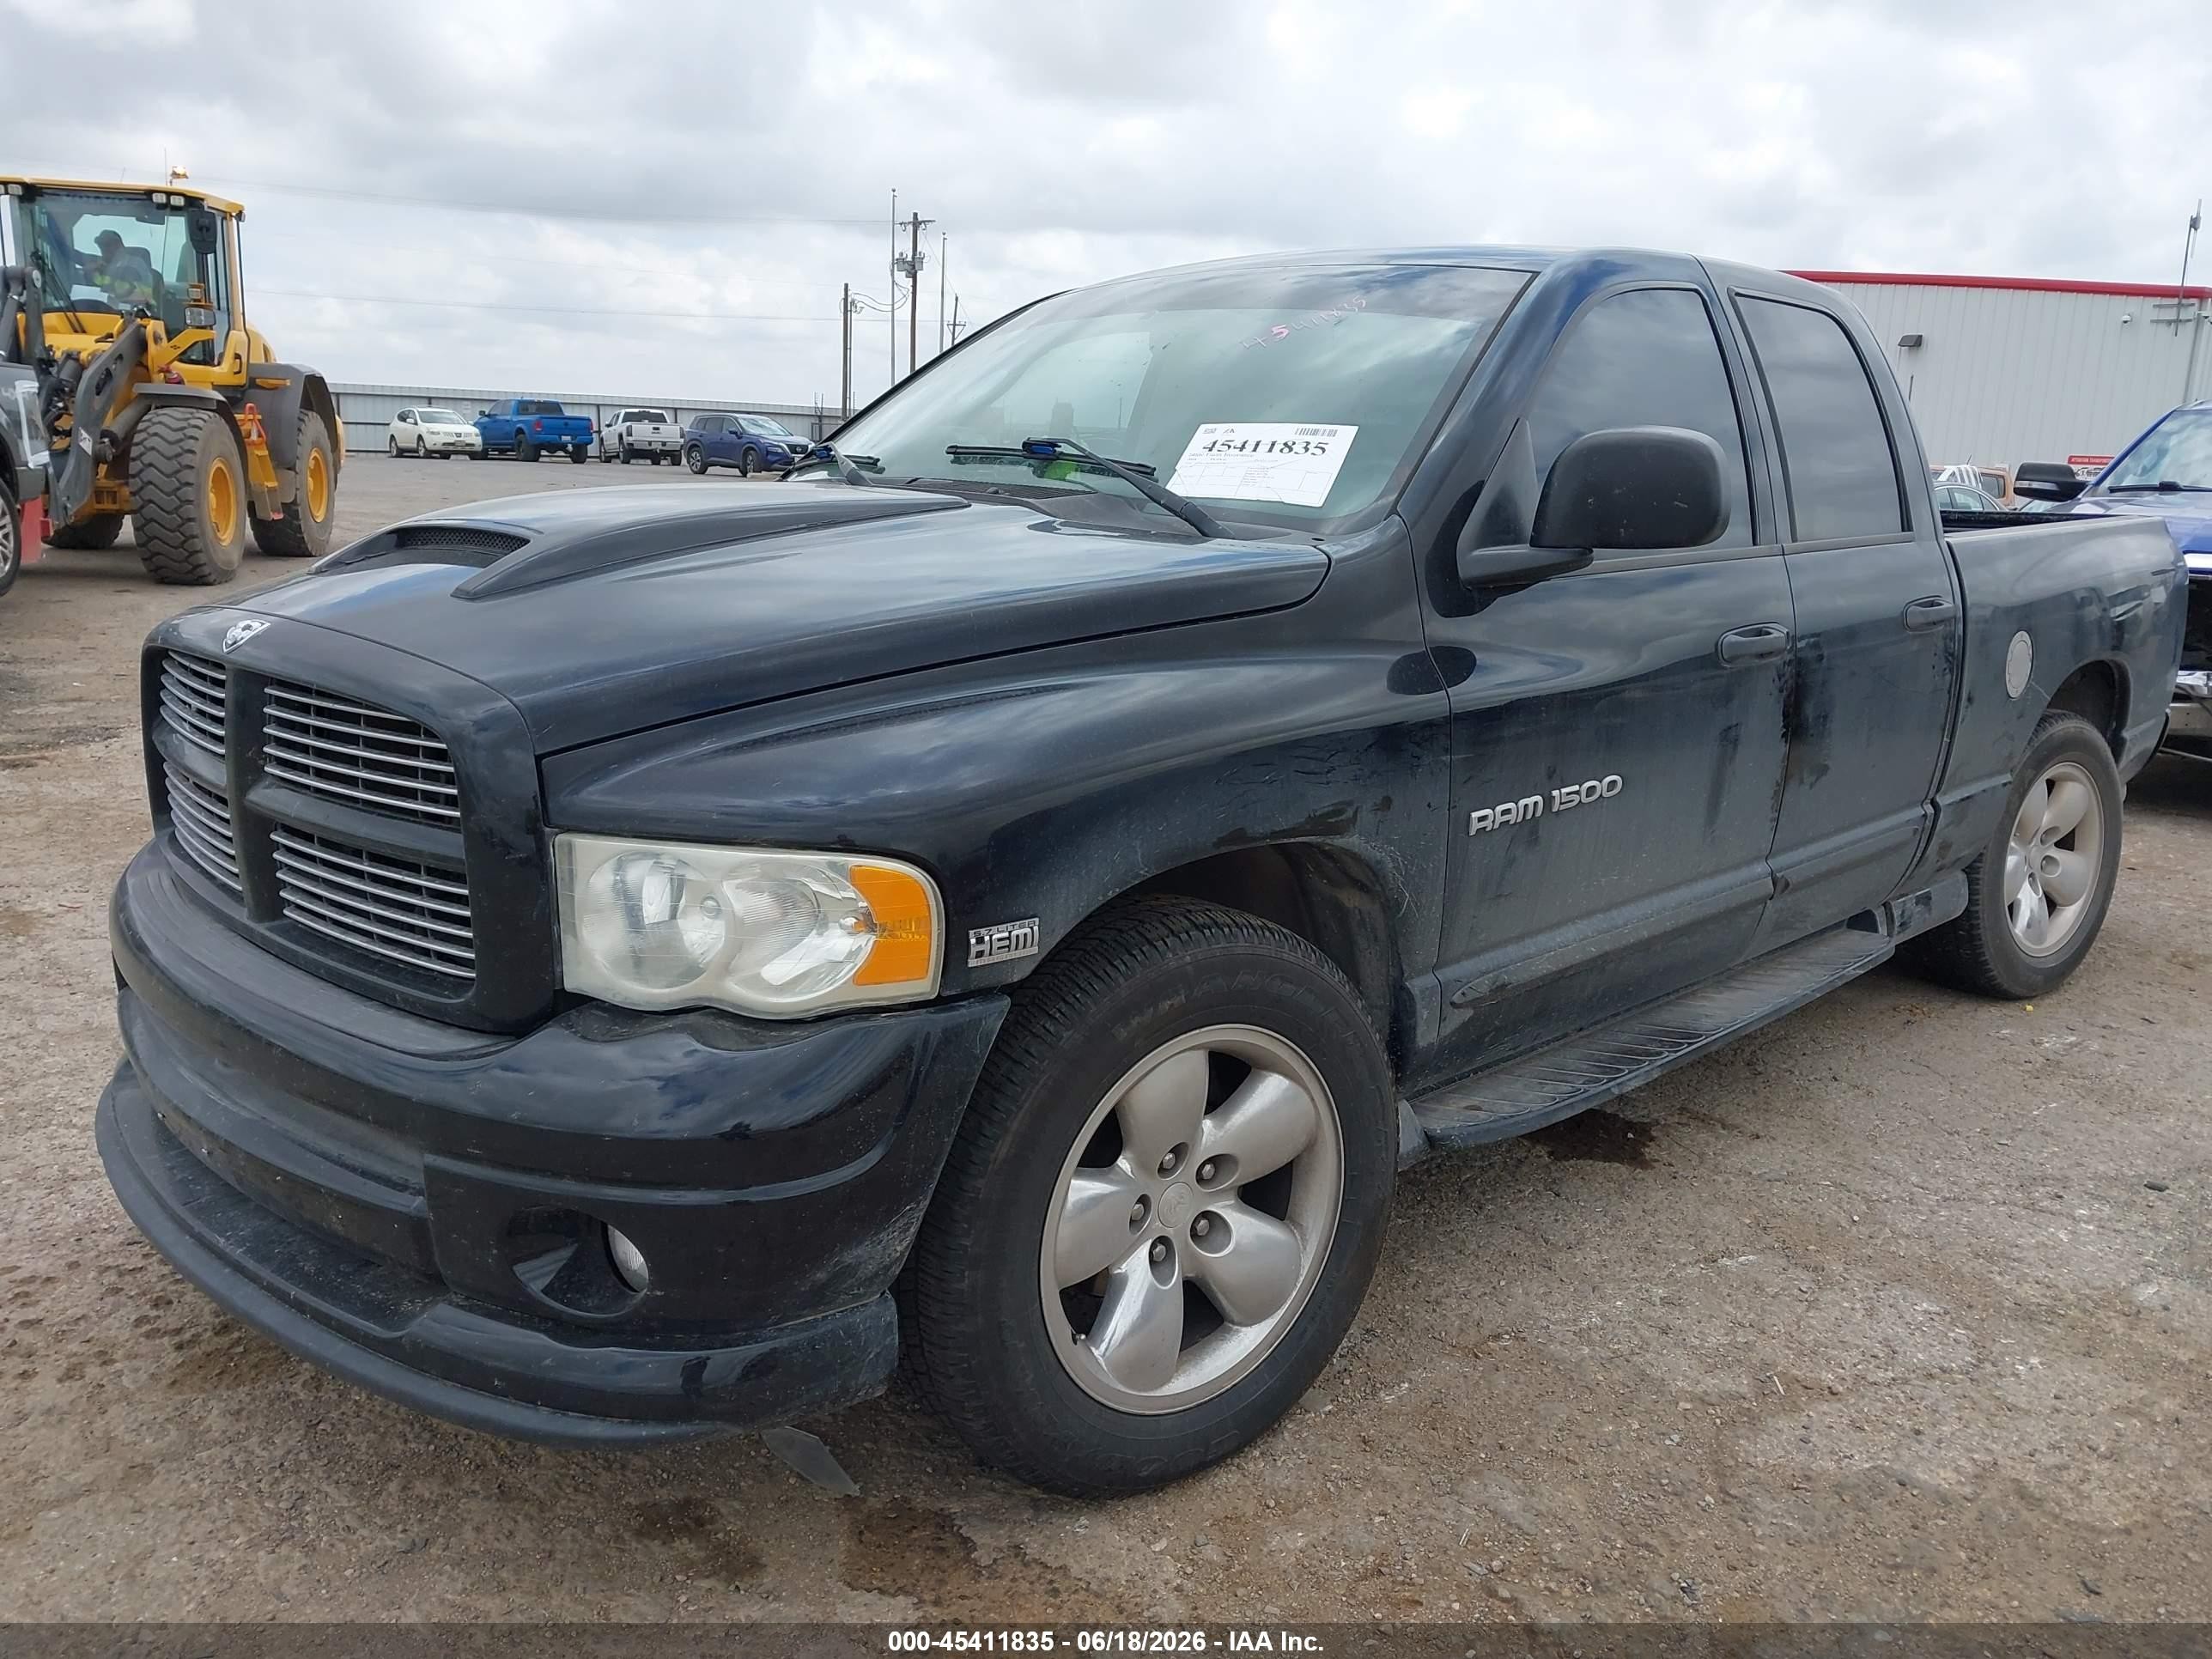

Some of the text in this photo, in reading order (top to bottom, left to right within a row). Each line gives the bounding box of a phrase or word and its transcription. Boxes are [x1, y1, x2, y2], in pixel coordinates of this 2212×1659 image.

[1202, 439, 1328, 457] 45411835
[1469, 775, 1623, 836] RAM 1500
[996, 920, 1036, 933] LITER
[969, 925, 1040, 960] HEMI
